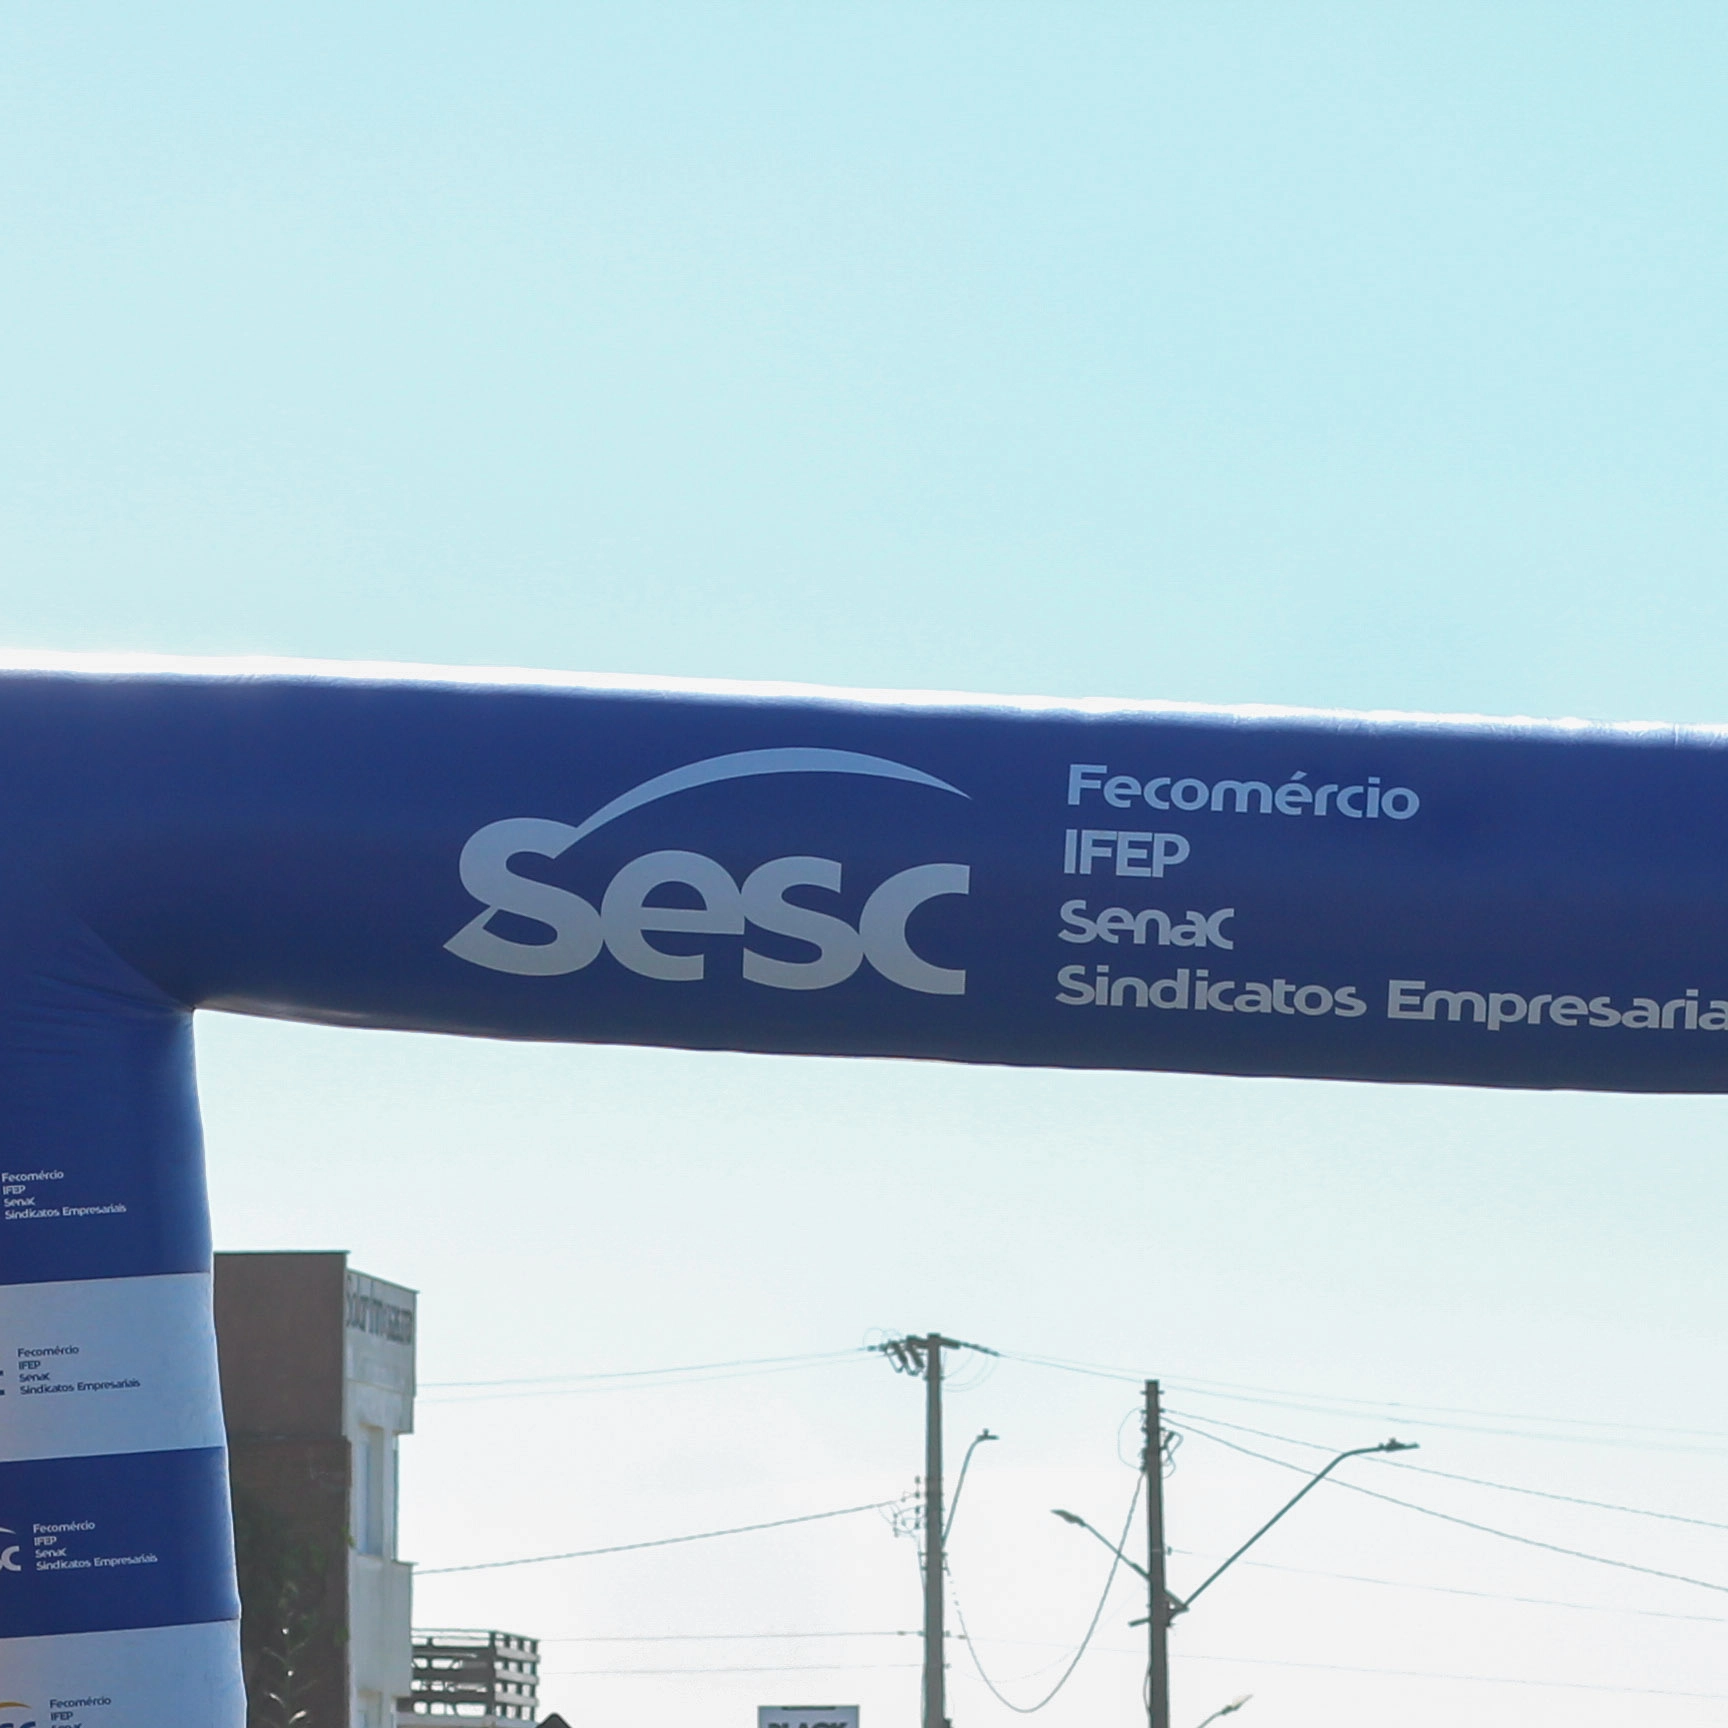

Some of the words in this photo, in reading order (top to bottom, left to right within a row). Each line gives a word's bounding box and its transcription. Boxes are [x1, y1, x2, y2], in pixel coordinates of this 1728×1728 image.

[1067, 764, 1420, 824] Fecomércio
[1062, 827, 1190, 878] IFEP
[442, 815, 971, 996] Sesc
[1057, 898, 1237, 952] Senac
[1054, 963, 1369, 1021] Sindicatos
[1, 1169, 65, 1182] Fecomércio
[2, 1183, 26, 1195] IFEP
[4, 1206, 61, 1220] Sindicatos
[62, 1202, 127, 1217] Empresariais
[17, 1344, 80, 1359] Fecomércio
[18, 1358, 42, 1370] IFEP
[19, 1381, 75, 1396] Sindicatos
[77, 1376, 141, 1393] Empresariais
[33, 1521, 96, 1534] Fecomércio
[33, 1534, 58, 1546] IFEP
[35, 1557, 92, 1572] Sindicatos
[93, 1552, 158, 1568] Empresariais
[49, 1696, 112, 1709] Fecomércio
[50, 1709, 74, 1721] IFEP
